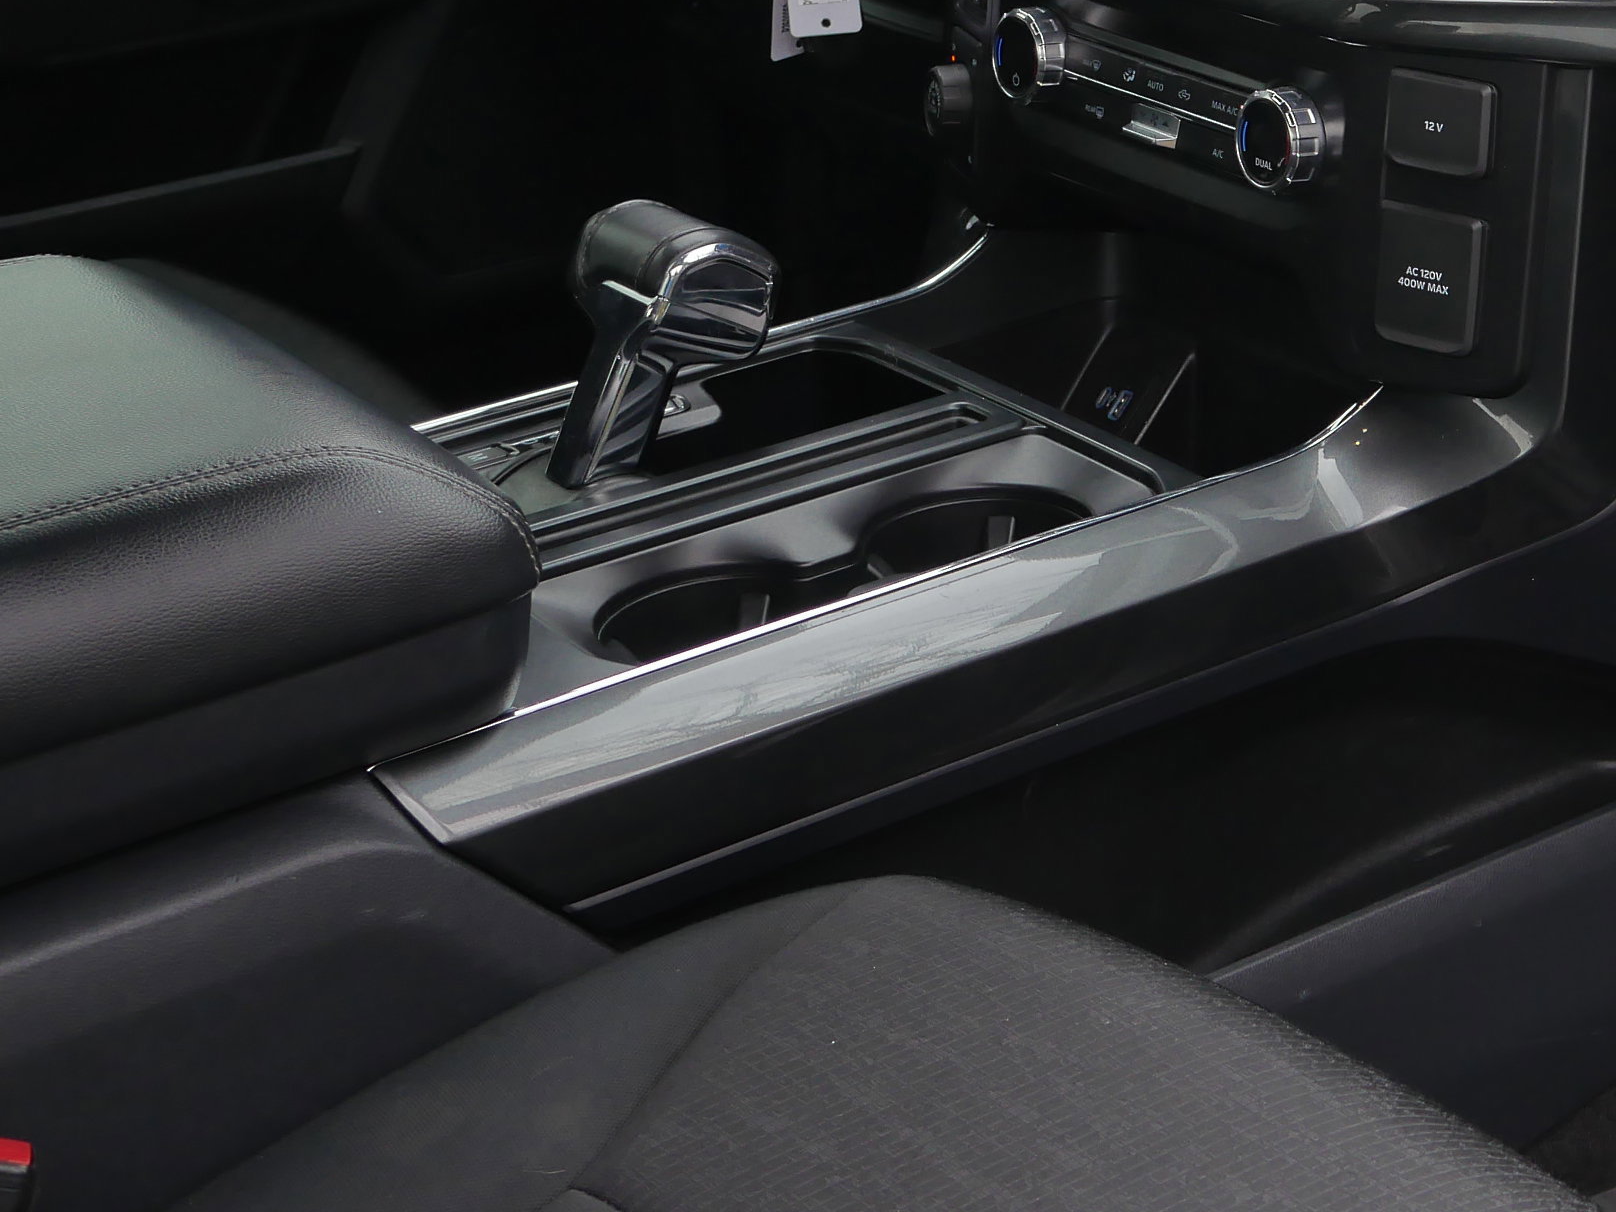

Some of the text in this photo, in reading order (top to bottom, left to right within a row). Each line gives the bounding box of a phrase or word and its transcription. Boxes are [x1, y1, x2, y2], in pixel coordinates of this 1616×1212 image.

[1147, 79, 1165, 92] AUTO
[1424, 120, 1444, 133] 12 V
[1255, 157, 1273, 171] DUAL
[1406, 265, 1443, 282] AC 120V
[1397, 276, 1449, 295] 400W MAX
